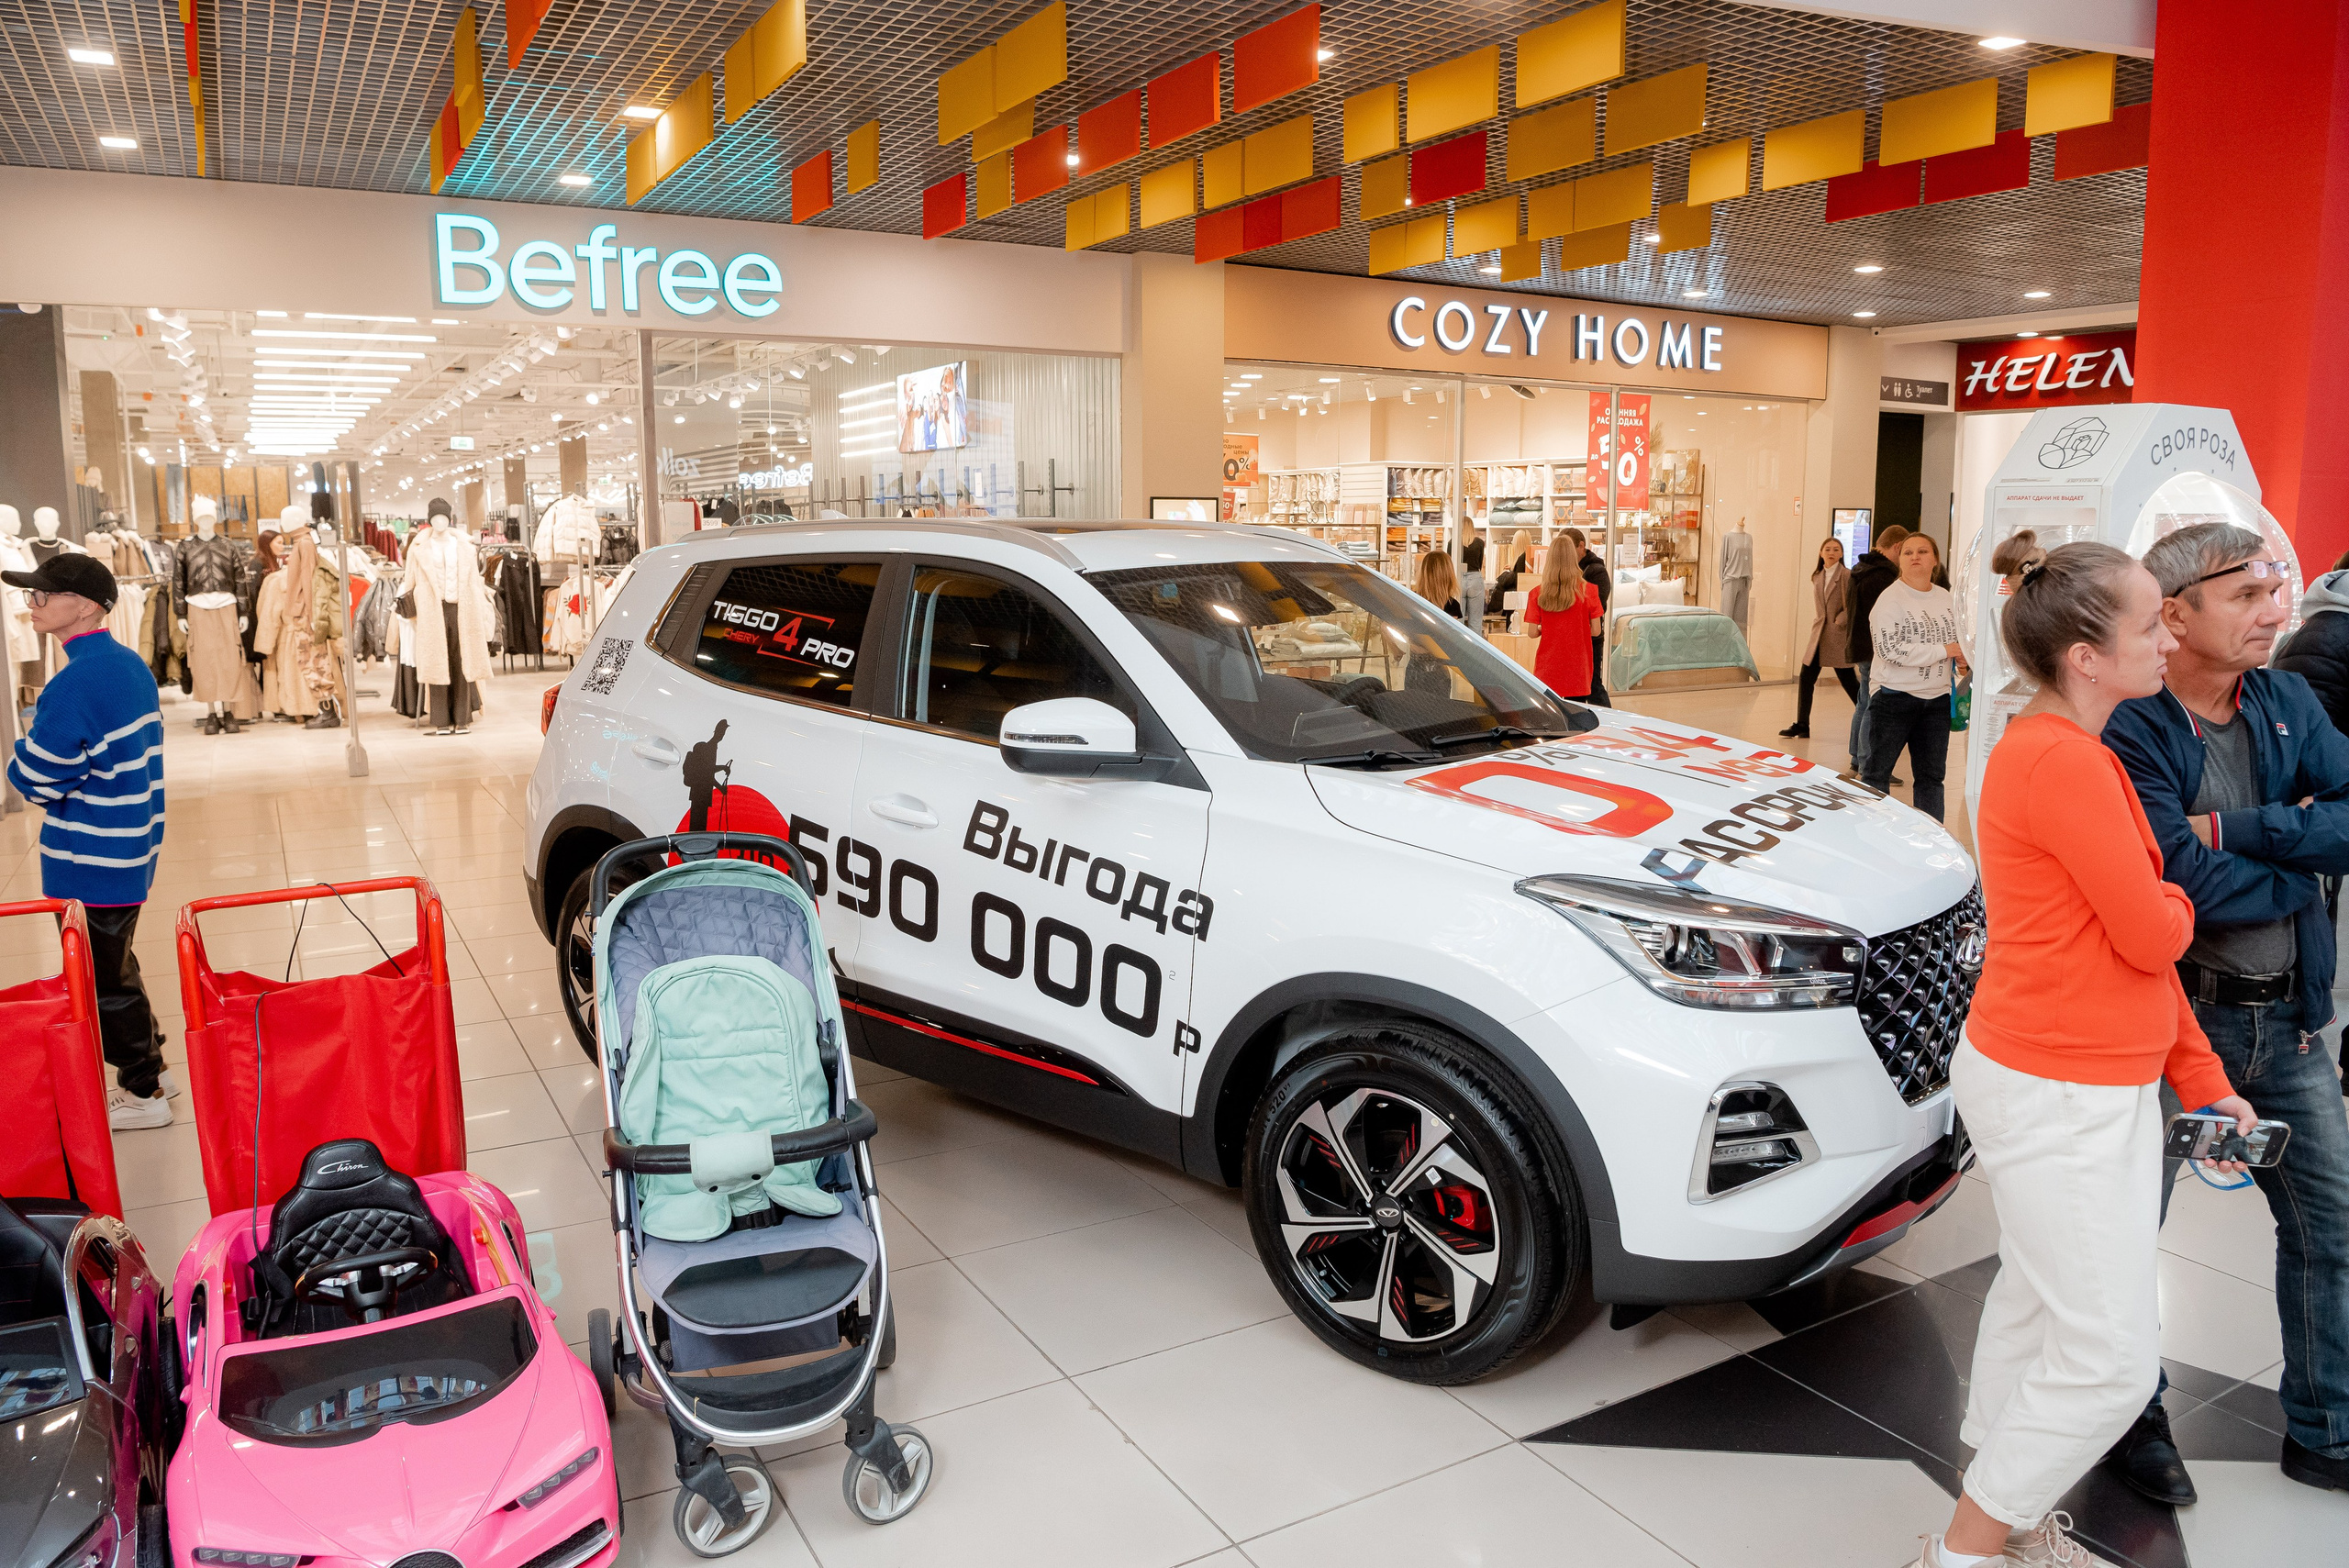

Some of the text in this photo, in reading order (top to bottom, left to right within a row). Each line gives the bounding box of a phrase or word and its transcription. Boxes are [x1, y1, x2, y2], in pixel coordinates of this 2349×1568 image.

[435, 213, 783, 317] Befree
[1390, 296, 1723, 371] COZY HOME
[1596, 417, 1643, 428] РАСОДАЖА
[1604, 407, 1637, 417] ОННЯЯ
[1223, 457, 1250, 481] 0%
[2151, 428, 2235, 472] СВОЯ РОЗА
[713, 600, 855, 669] TIGGO 4 PRO
[723, 628, 760, 644] CHERY
[963, 799, 1215, 942] Выгода
[789, 814, 940, 942] 590
[970, 891, 1163, 1039] 000
[317, 1160, 369, 1174] Chiron
